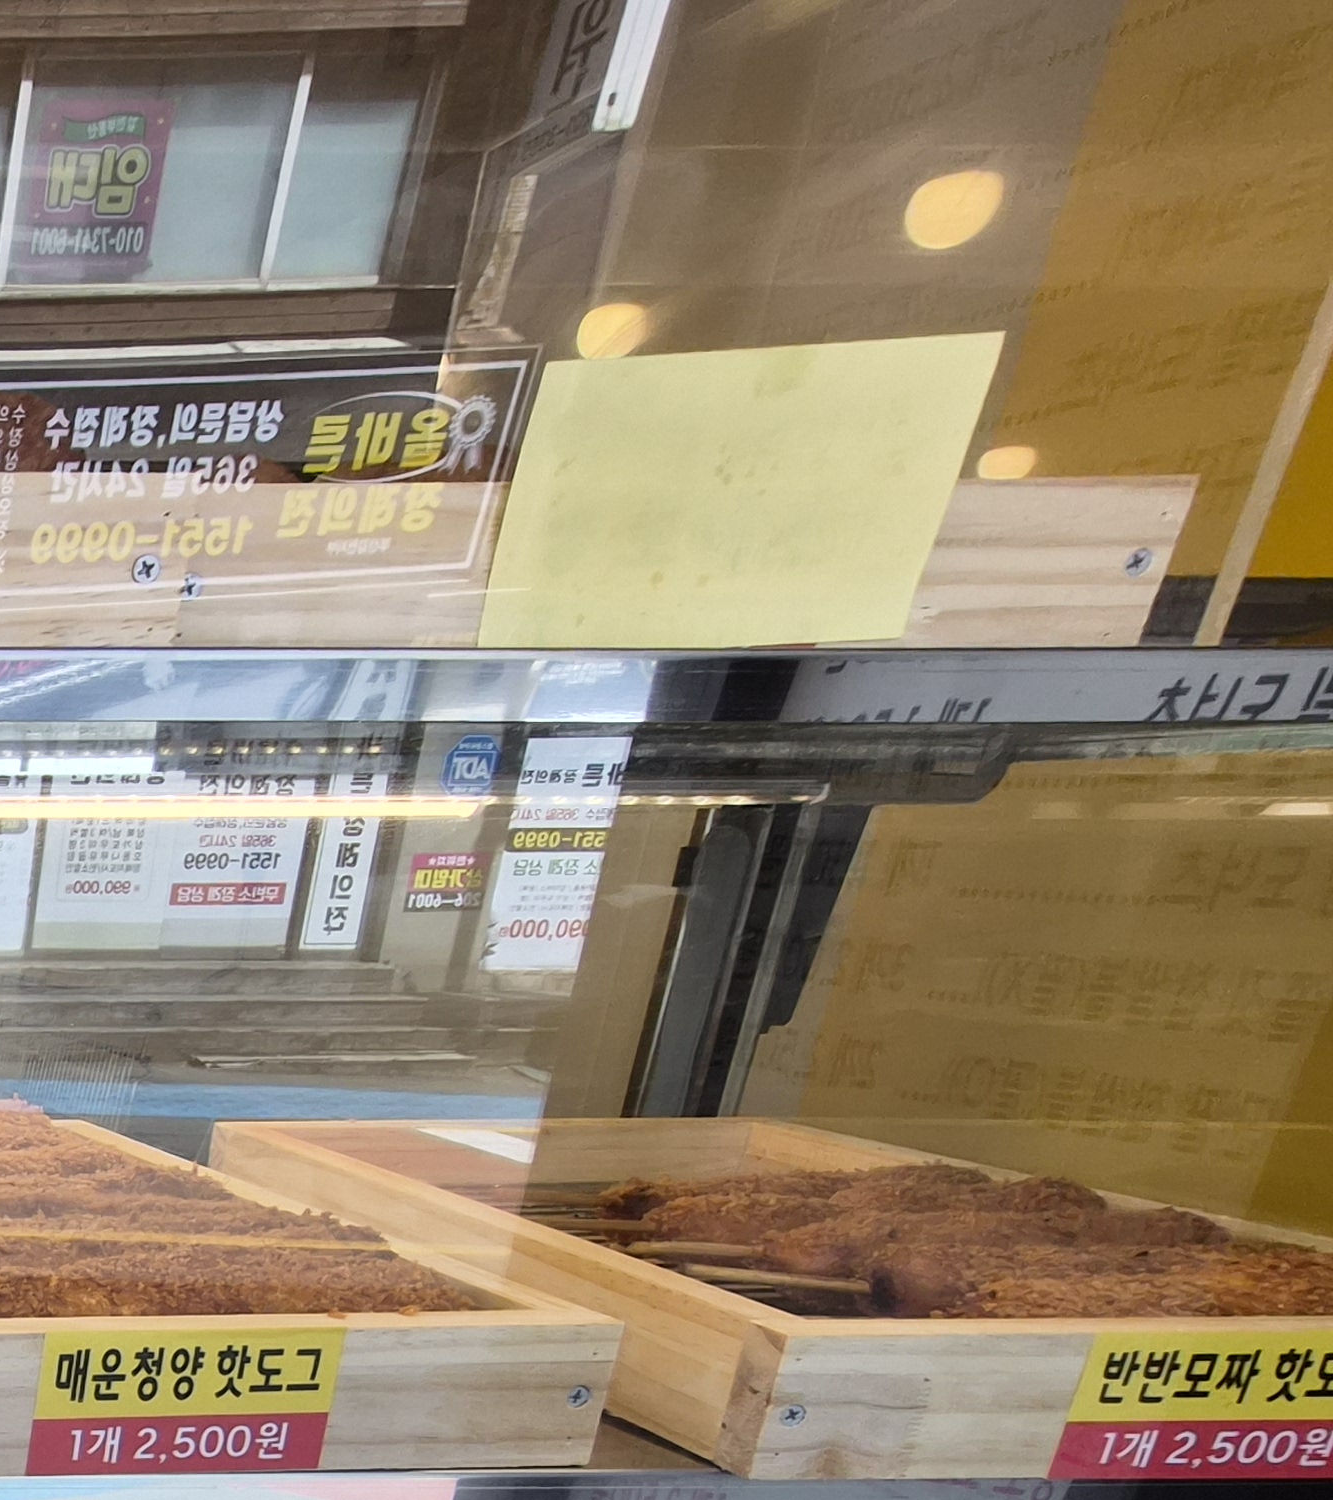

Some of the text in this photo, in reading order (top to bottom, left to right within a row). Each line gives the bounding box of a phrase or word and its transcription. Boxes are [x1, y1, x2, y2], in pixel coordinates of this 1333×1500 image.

[55, 1344, 323, 1403] 매운청양 핫도그
[1098, 1349, 1264, 1404] 반반모짜
[69, 1422, 289, 1464] 1개 2,500원
[1098, 1427, 1333, 1469] 1개 2,500원
